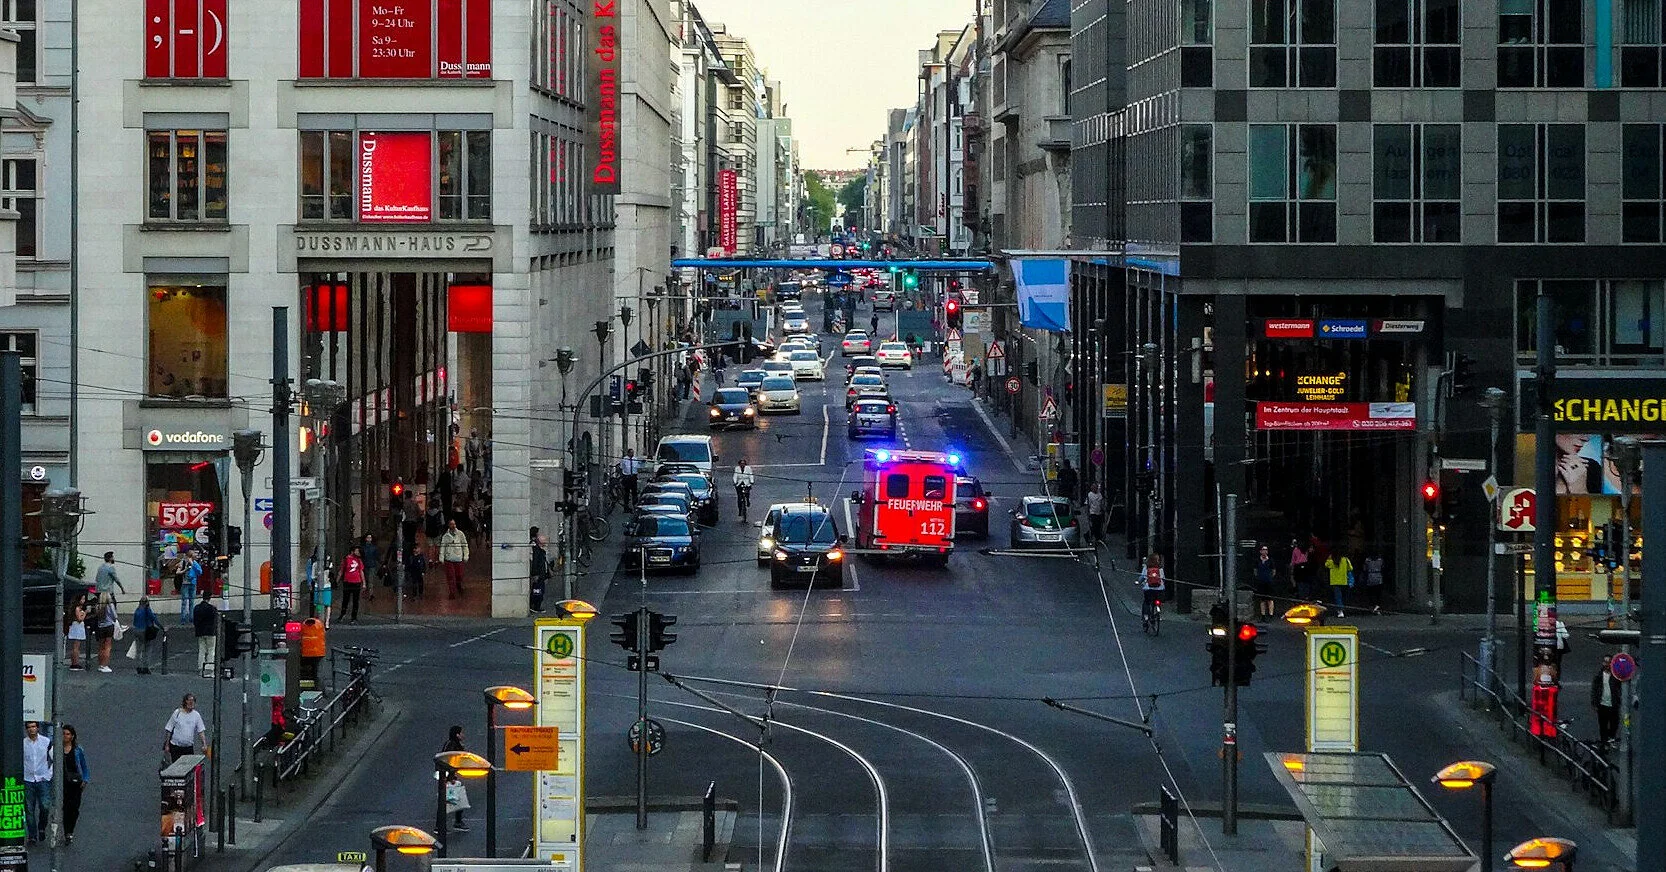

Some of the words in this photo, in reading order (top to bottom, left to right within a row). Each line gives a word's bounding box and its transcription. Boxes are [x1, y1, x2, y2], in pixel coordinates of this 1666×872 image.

[398, 18, 415, 28] Uhr
[372, 35, 383, 45] Sa
[595, 26, 615, 62] das
[372, 49, 396, 58] 23:30
[398, 48, 415, 58] Uhr
[593, 69, 615, 184] Dussmann
[362, 139, 377, 212] Dussmann
[296, 236, 455, 251] DUSSMANN-HAUS
[1331, 325, 1364, 333] Schroedel
[1385, 323, 1419, 331] Diesterweg
[165, 431, 224, 444] vodafone
[888, 498, 943, 512] FEUERWEHR
[163, 507, 209, 526] 50%
[920, 521, 945, 535] 112
[341, 853, 363, 861] TAXI
